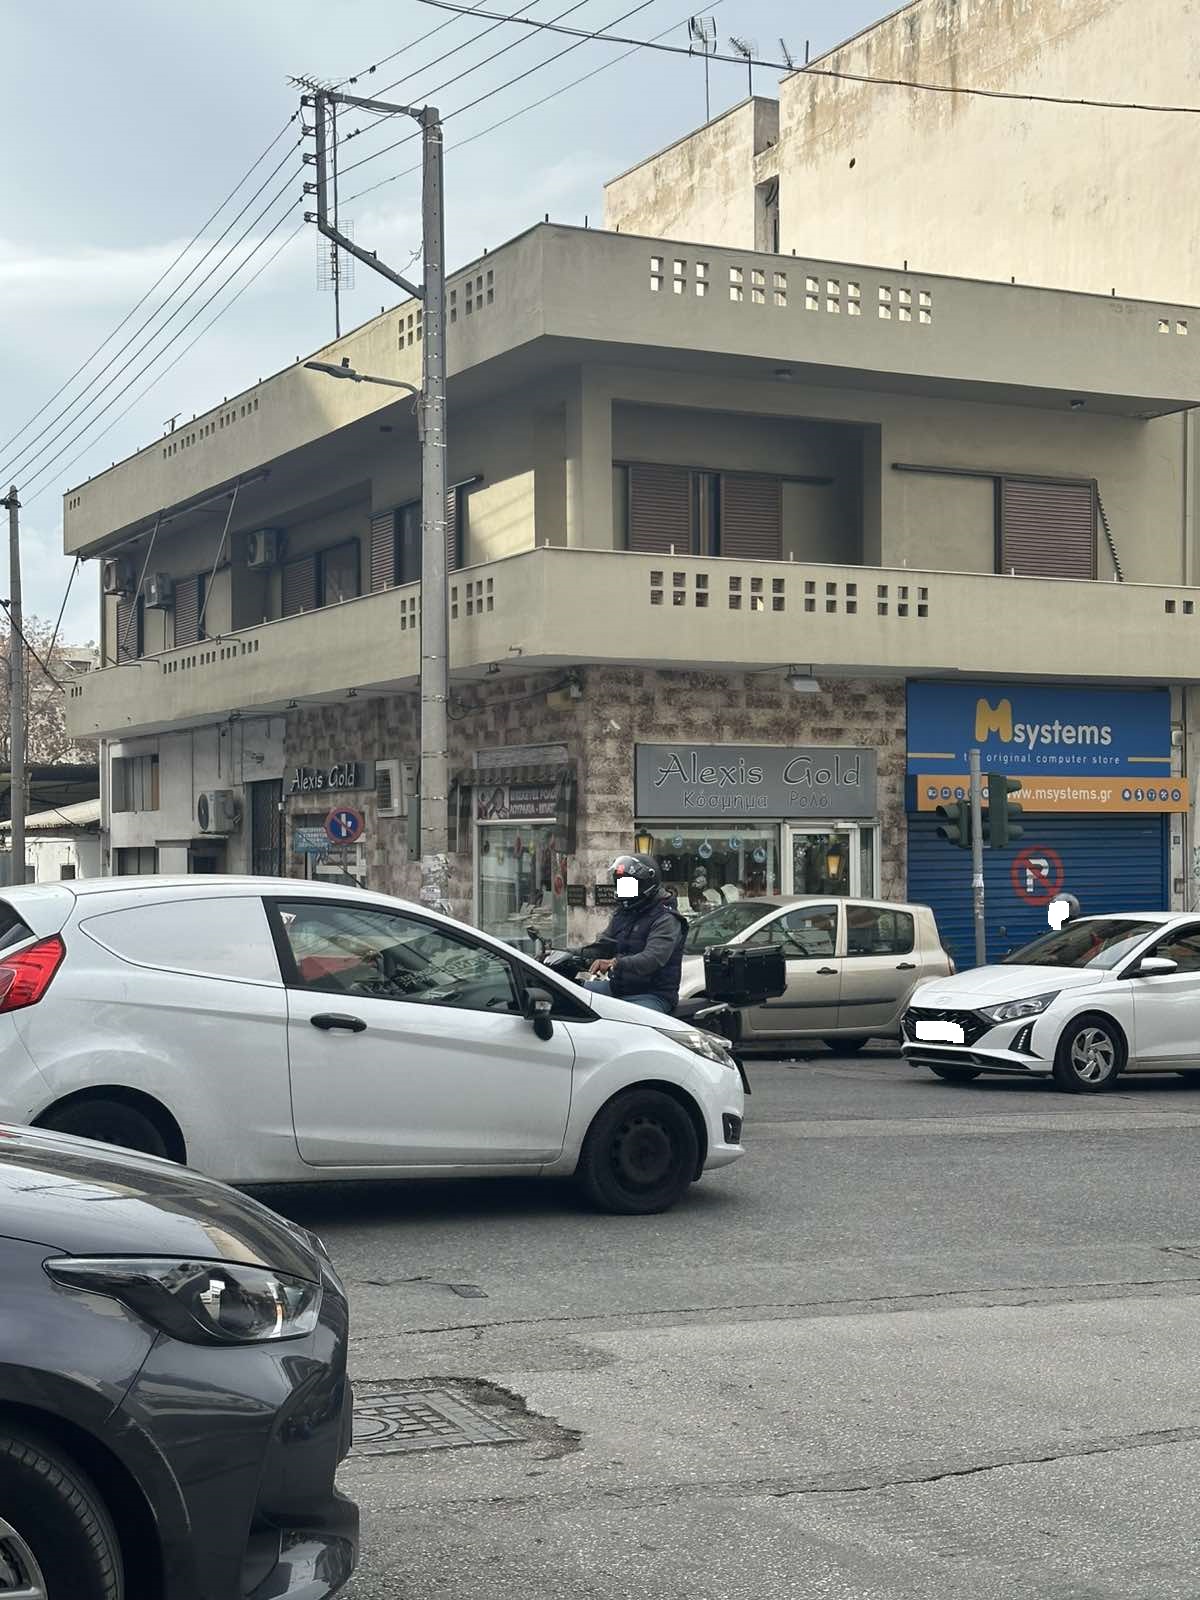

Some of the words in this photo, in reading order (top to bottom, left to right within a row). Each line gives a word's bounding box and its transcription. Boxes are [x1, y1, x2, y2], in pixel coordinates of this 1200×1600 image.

[975, 698, 1111, 750] Msystems
[654, 752, 763, 788] Alexis
[783, 754, 861, 788] Gold
[986, 752, 1032, 764] original
[1036, 753, 1087, 765] computer
[1092, 755, 1121, 765] store
[289, 768, 323, 792] Alexis
[328, 762, 355, 787] Gold
[683, 790, 769, 814] Κόσμημα
